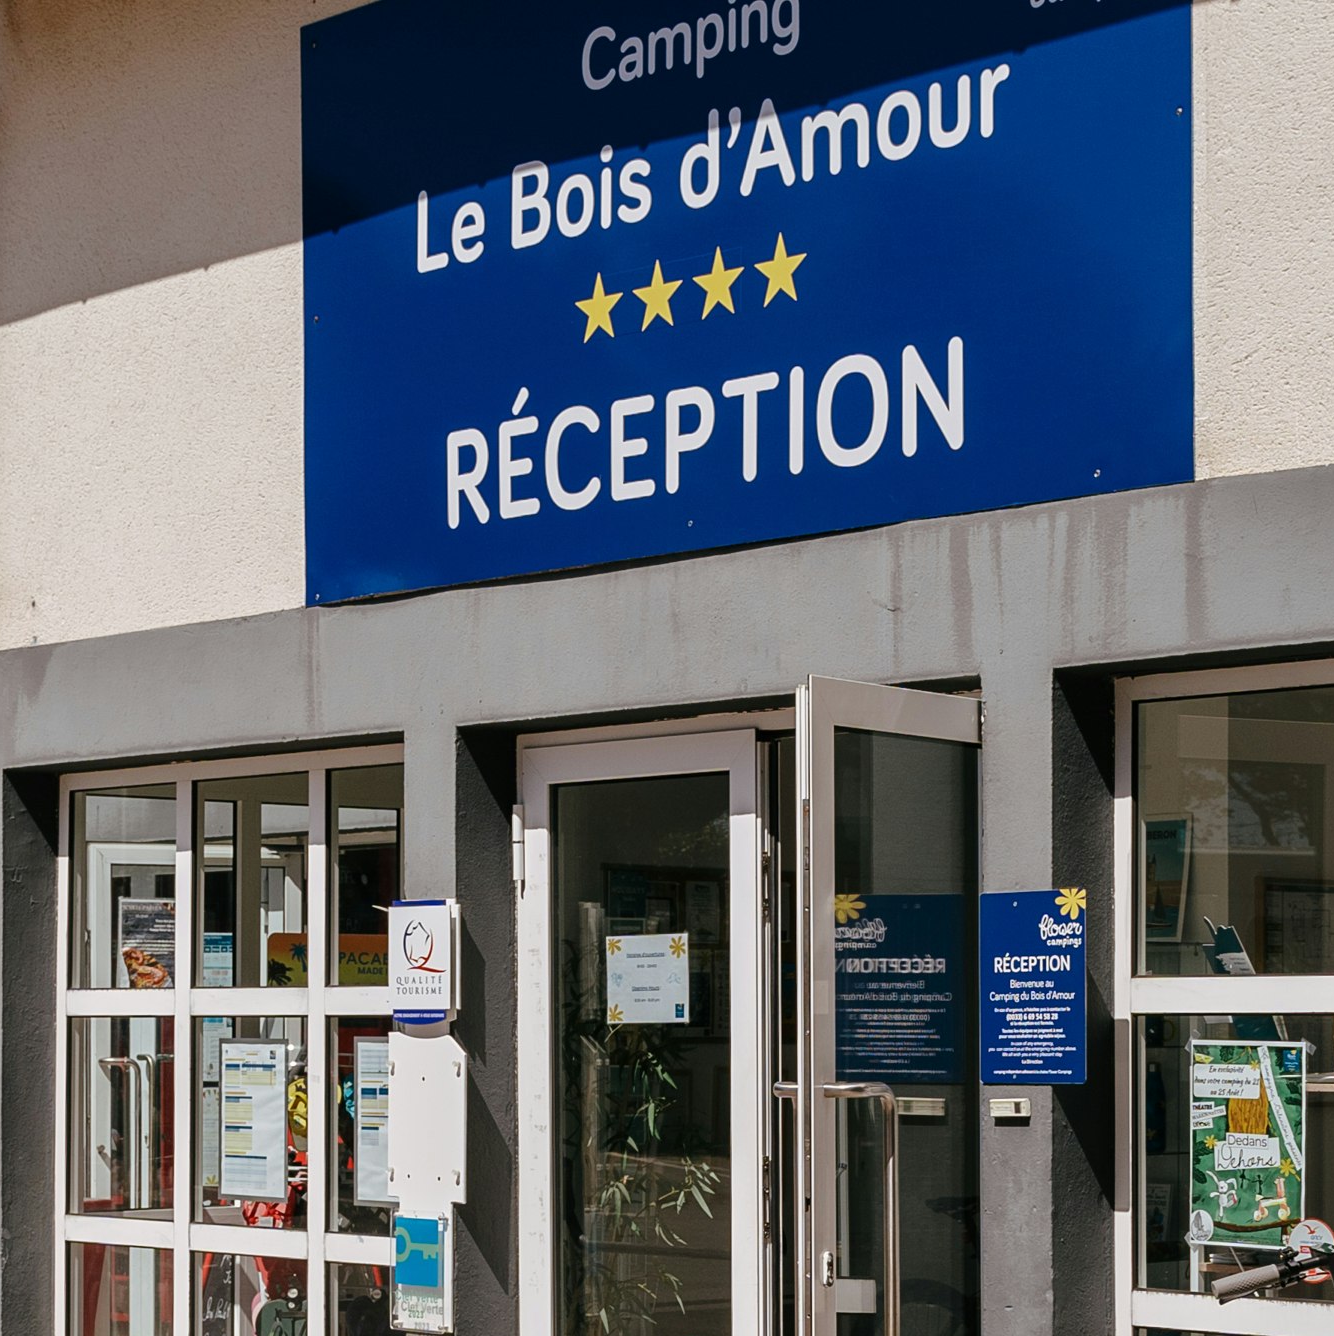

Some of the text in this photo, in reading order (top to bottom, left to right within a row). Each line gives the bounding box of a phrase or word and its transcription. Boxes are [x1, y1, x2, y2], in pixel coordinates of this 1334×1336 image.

[581, 0, 801, 91] Camping
[415, 62, 1011, 275] Le Bois d'Amour
[446, 334, 965, 531] RÉCEPTION
[1038, 914, 1082, 940] flower
[1046, 936, 1082, 948] campings
[994, 952, 1071, 973] RÉCEPTION
[357, 967, 383, 975] MADE
[396, 975, 442, 986] QUALITÉ
[1009, 979, 1054, 989] Bienvenue au
[396, 986, 443, 995] TOURISME
[989, 990, 1076, 1003] Camping du Bois d'Amour
[1221, 1078, 1244, 1087] camping
[1227, 1134, 1268, 1148] Dedans
[408, 1309, 424, 1318] 2023
